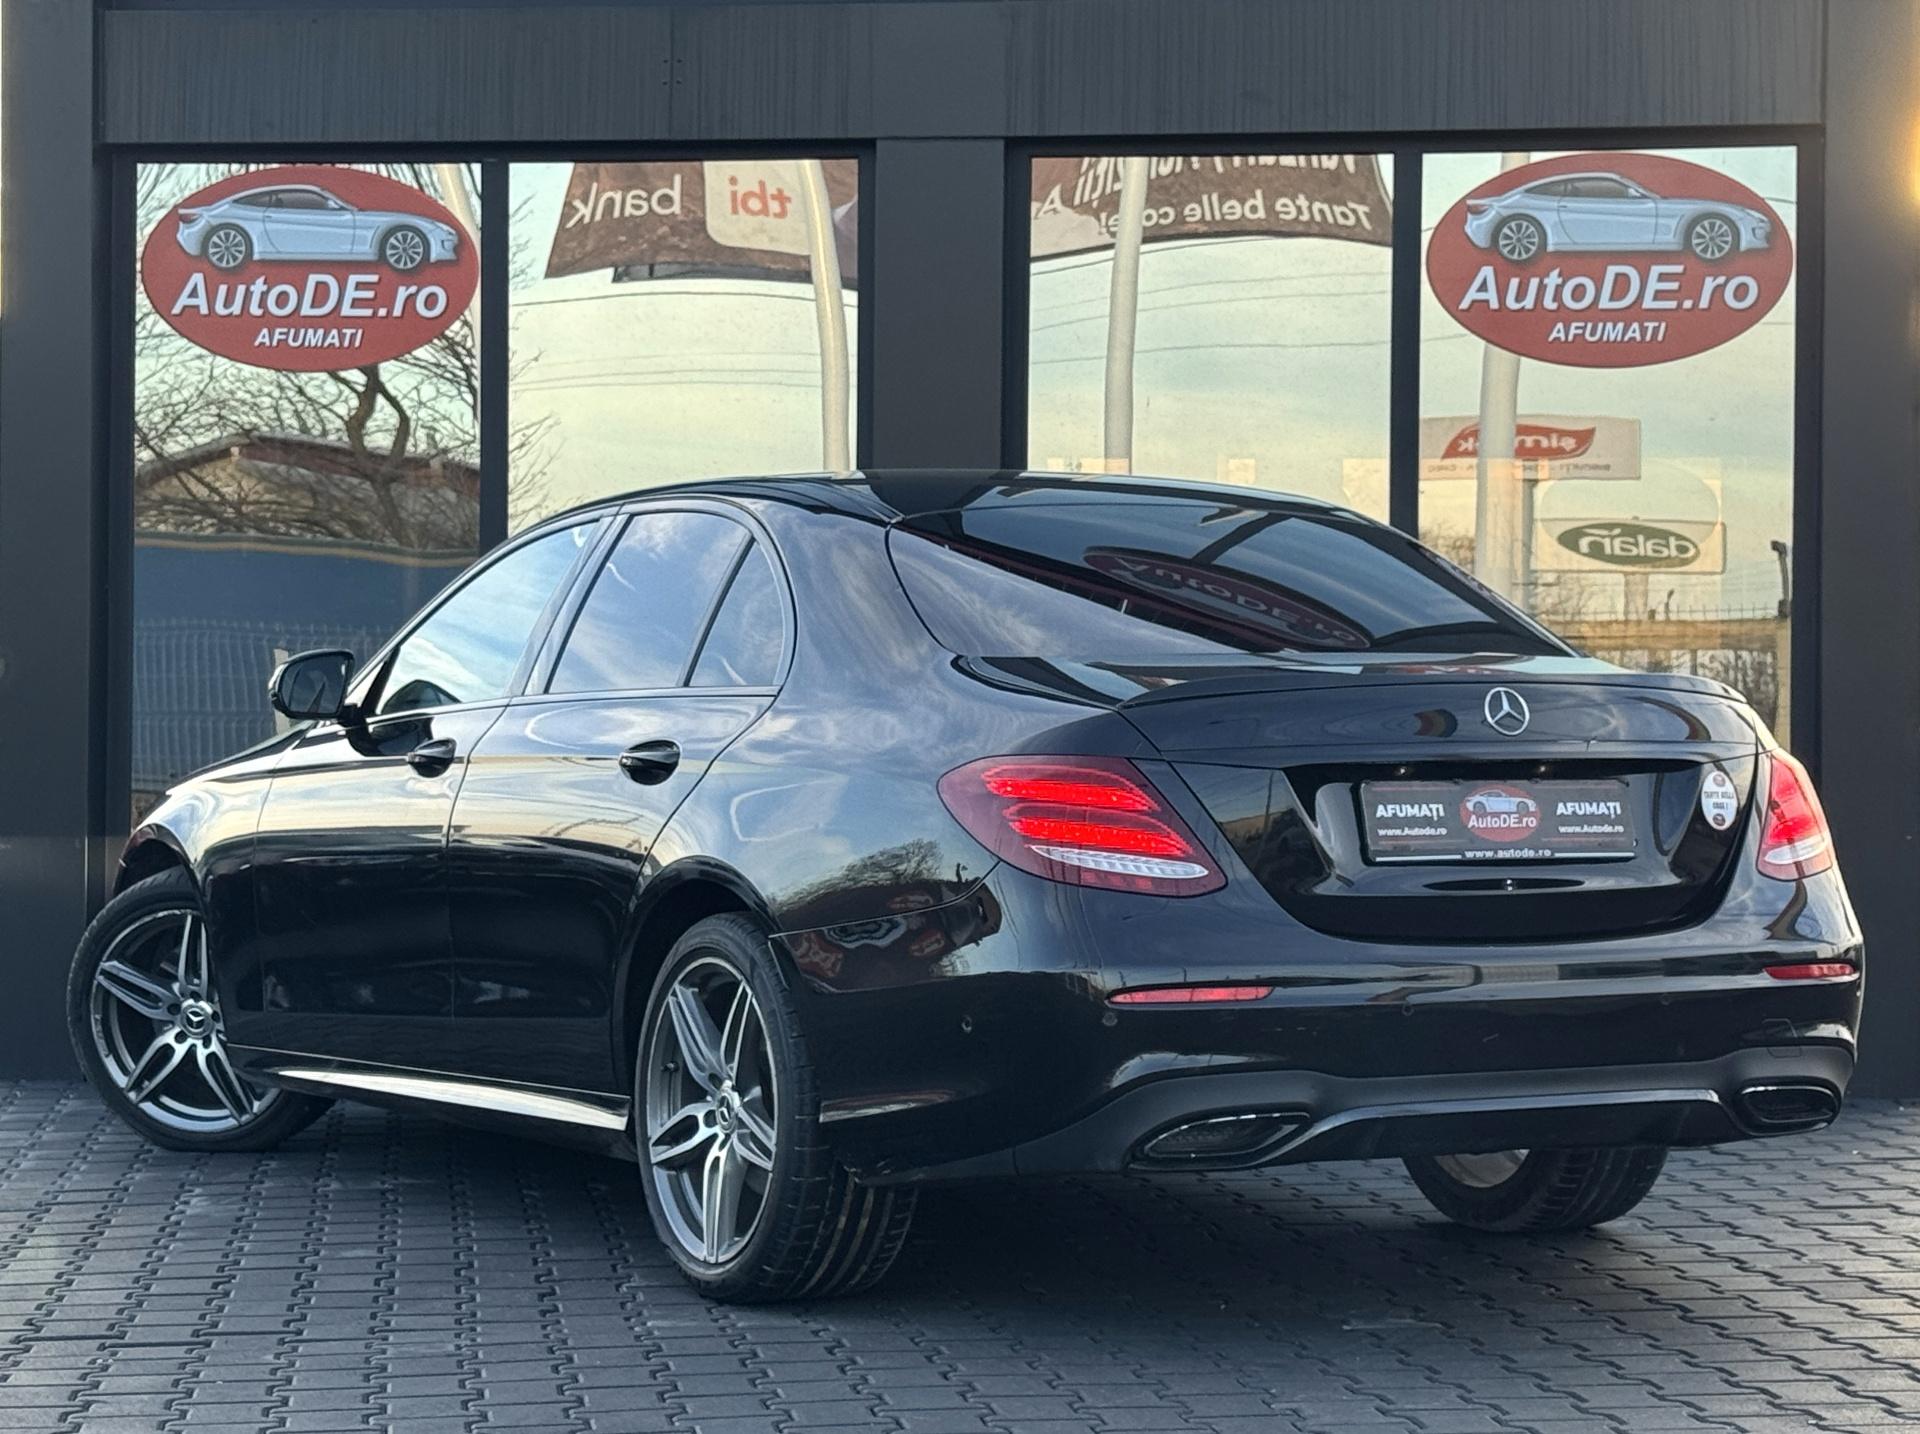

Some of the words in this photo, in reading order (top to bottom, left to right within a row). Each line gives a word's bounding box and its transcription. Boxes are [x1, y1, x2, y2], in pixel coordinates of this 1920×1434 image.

[170, 272, 449, 318] AutoDE.ro
[1458, 264, 1760, 311] AutoDE.ro
[253, 327, 364, 348] AFUMATI
[1547, 321, 1667, 343] AFUMATI
[1467, 813, 1537, 829] AutoDE.ro
